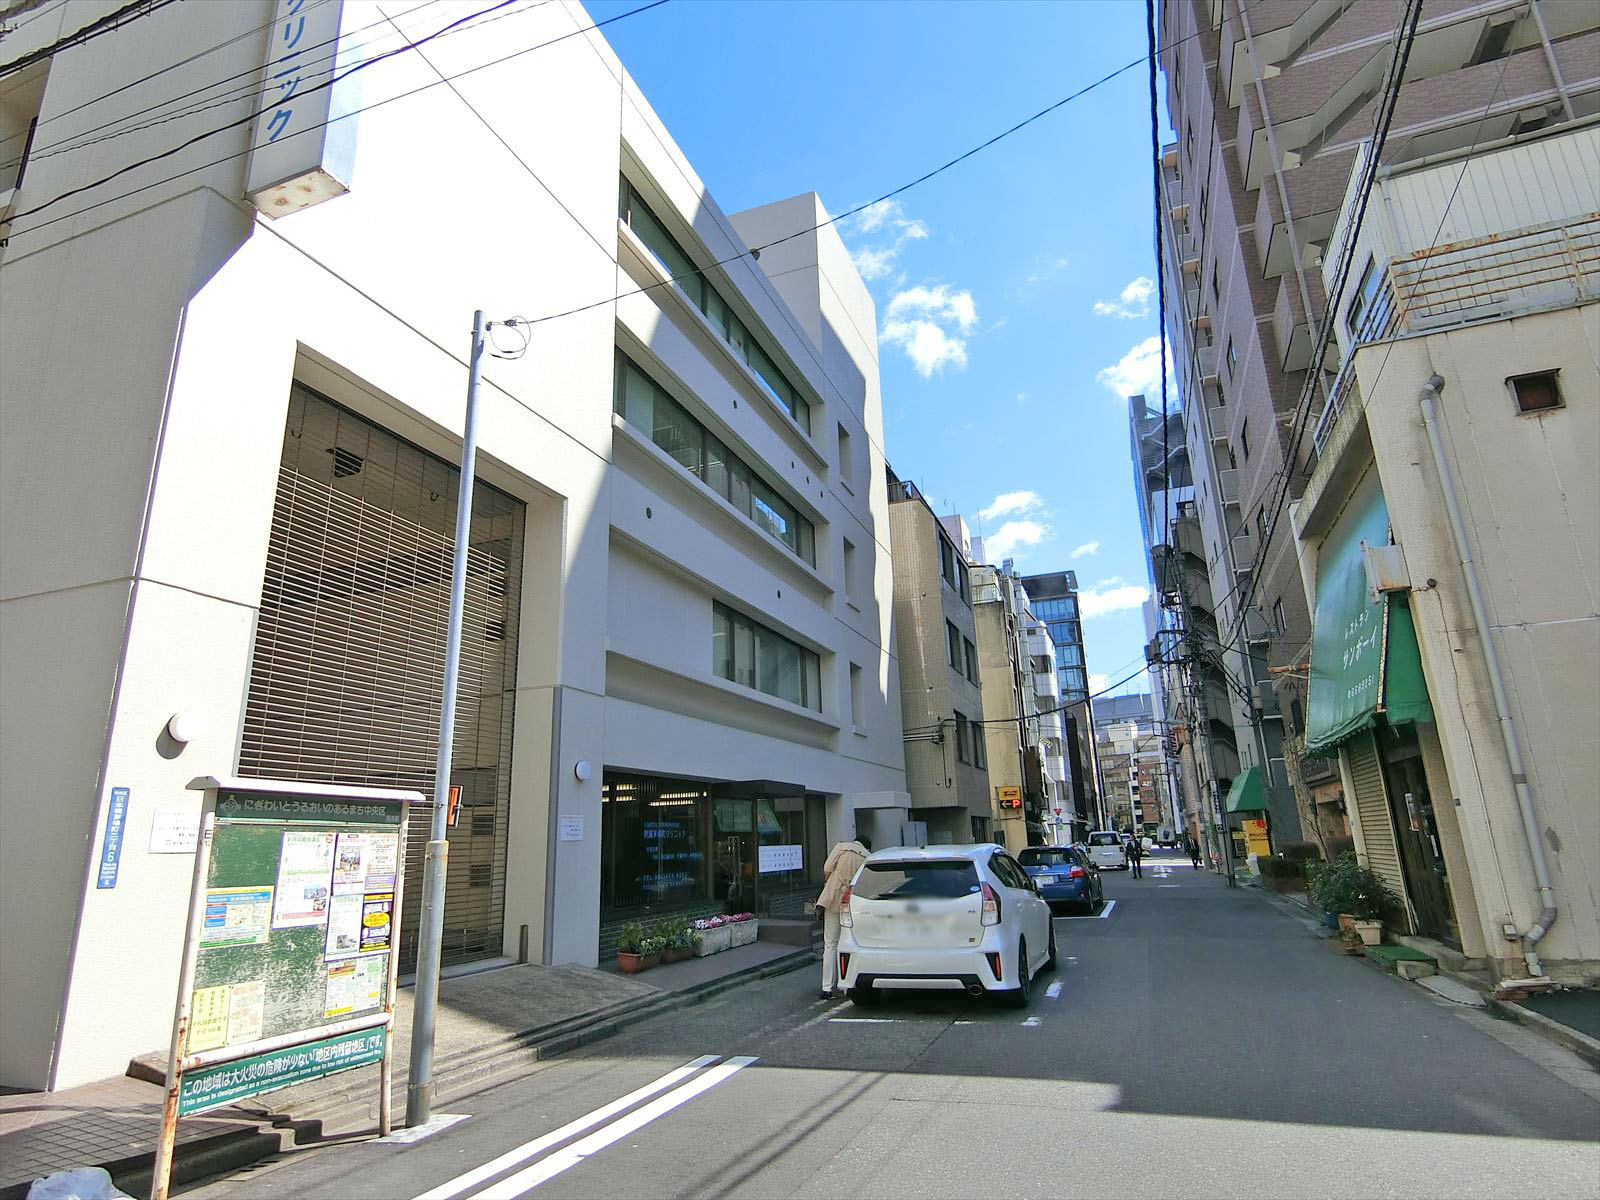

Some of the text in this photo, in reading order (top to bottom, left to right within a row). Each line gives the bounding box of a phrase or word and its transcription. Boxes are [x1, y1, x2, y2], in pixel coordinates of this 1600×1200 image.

[1344, 609, 1370, 640] レストラン
[243, 799, 387, 816] にぎわいとうるおいのあるまち中央区
[1012, 799, 1021, 809] P
[183, 1099, 196, 1107] This
[196, 1095, 210, 1103] area
[217, 1083, 249, 1098] designated
[260, 1071, 299, 1086] non-evacuation
[299, 1067, 312, 1075] zone
[312, 1064, 321, 1072] due
[327, 1060, 336, 1068] low
